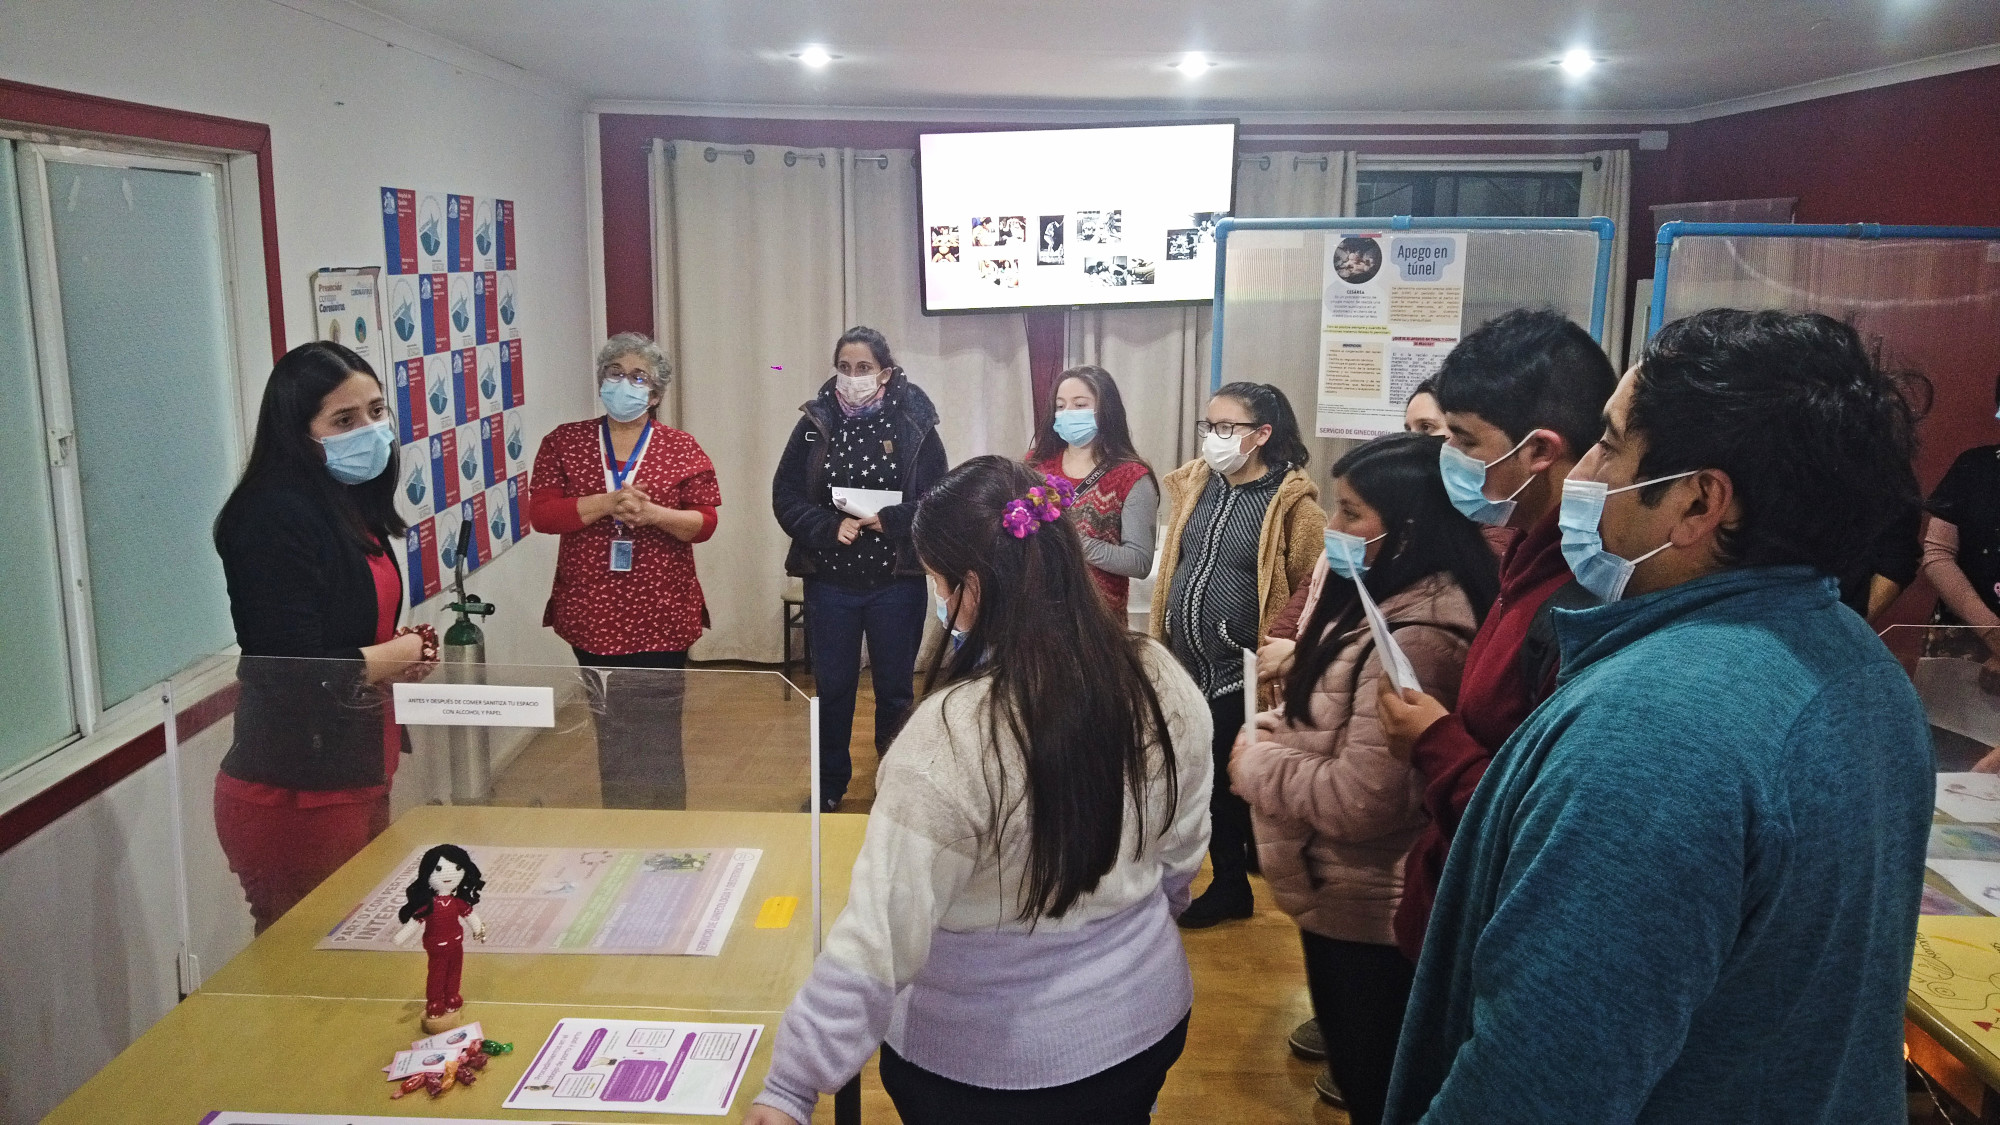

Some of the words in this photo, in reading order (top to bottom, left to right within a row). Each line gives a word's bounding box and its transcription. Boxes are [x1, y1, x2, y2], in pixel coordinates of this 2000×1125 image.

[1398, 245, 1431, 261] Apego
[1434, 248, 1448, 258] en
[1408, 261, 1435, 275] túnel
[334, 914, 371, 942] PARTO
[366, 896, 388, 912] CON
